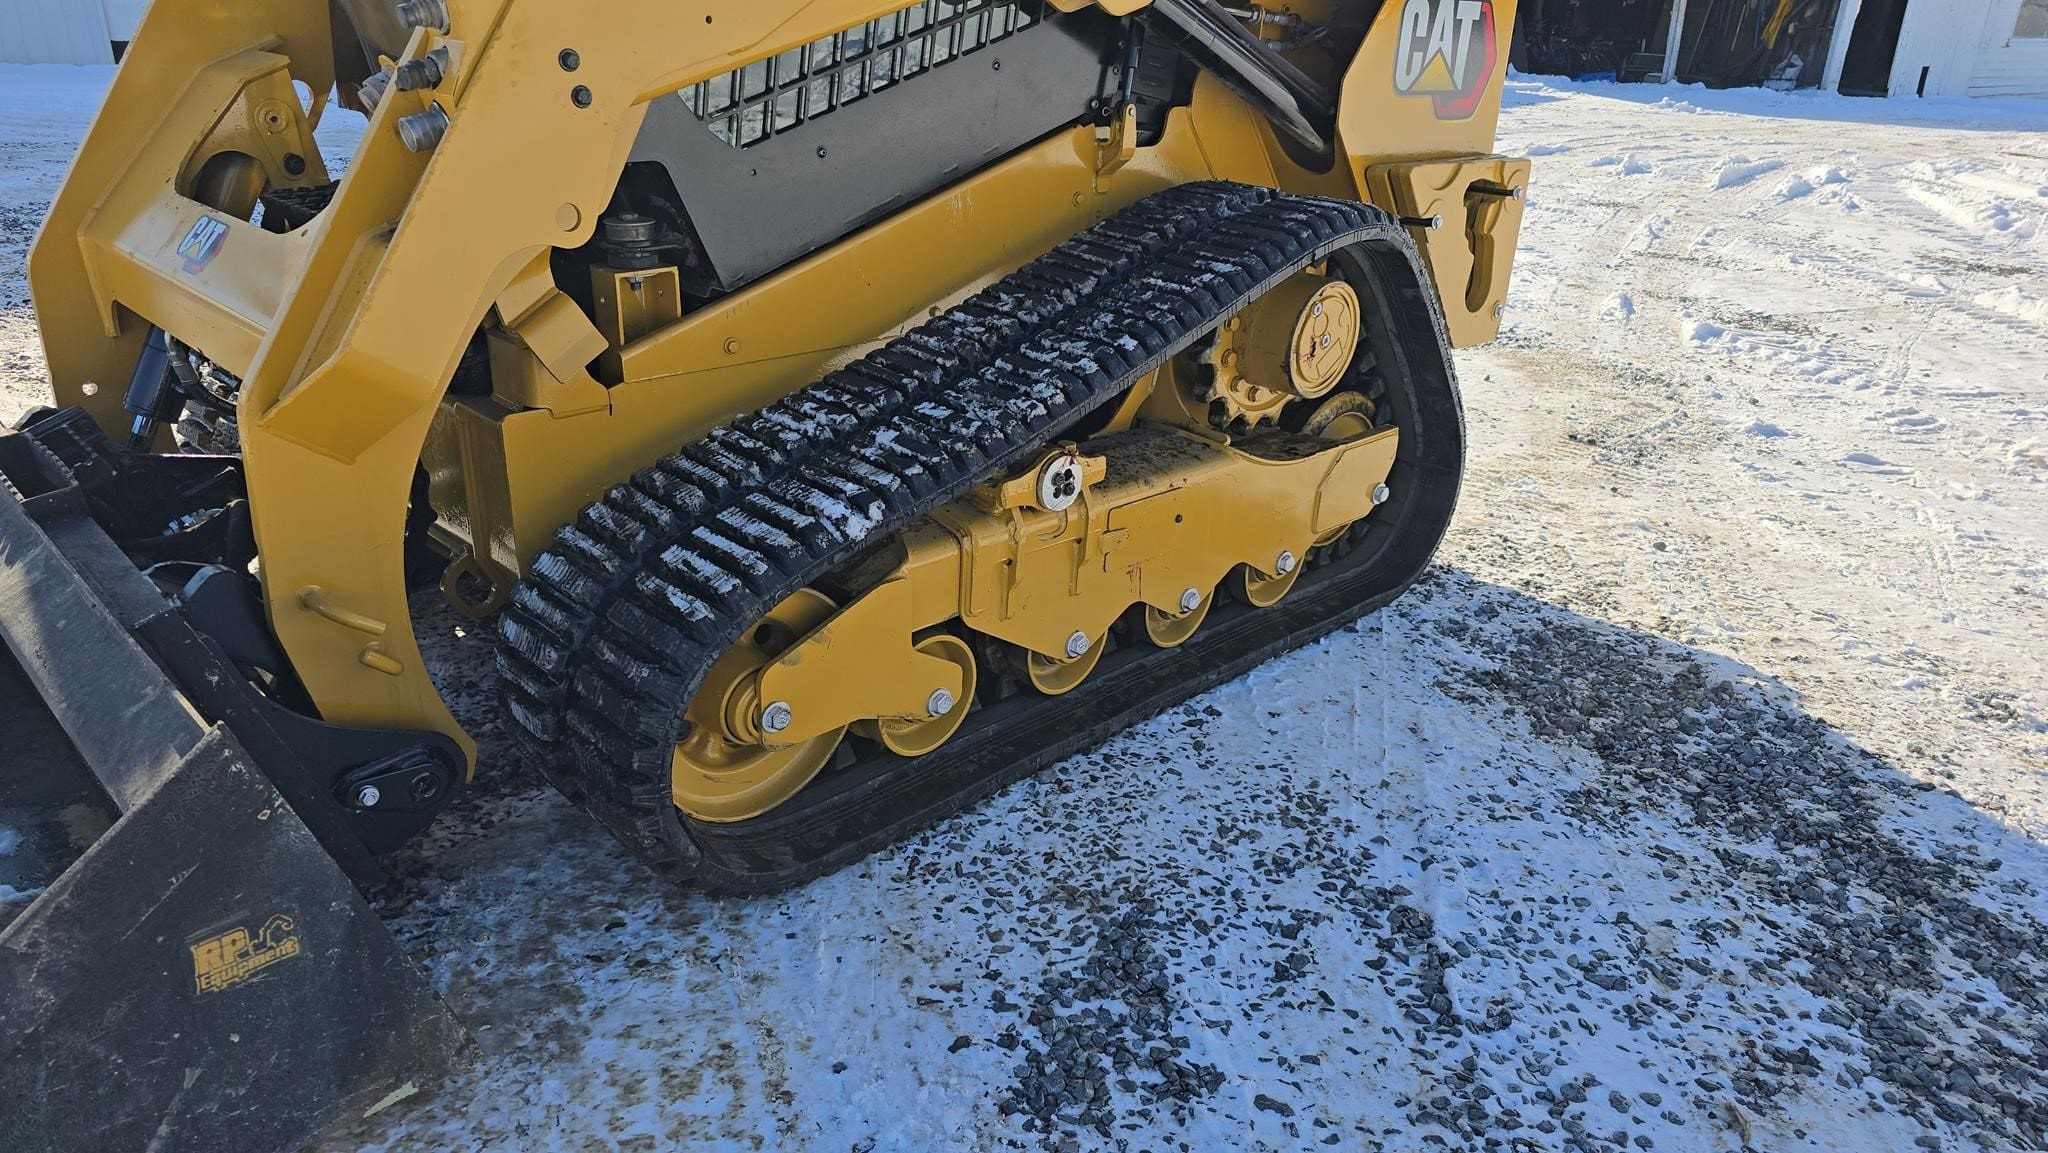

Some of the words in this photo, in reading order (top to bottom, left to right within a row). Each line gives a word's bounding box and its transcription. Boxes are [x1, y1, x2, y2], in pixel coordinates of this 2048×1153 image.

[1395, 0, 1482, 91] CAT
[178, 216, 226, 261] CAT
[195, 929, 247, 976] RP
[200, 938, 298, 990] Equipment
